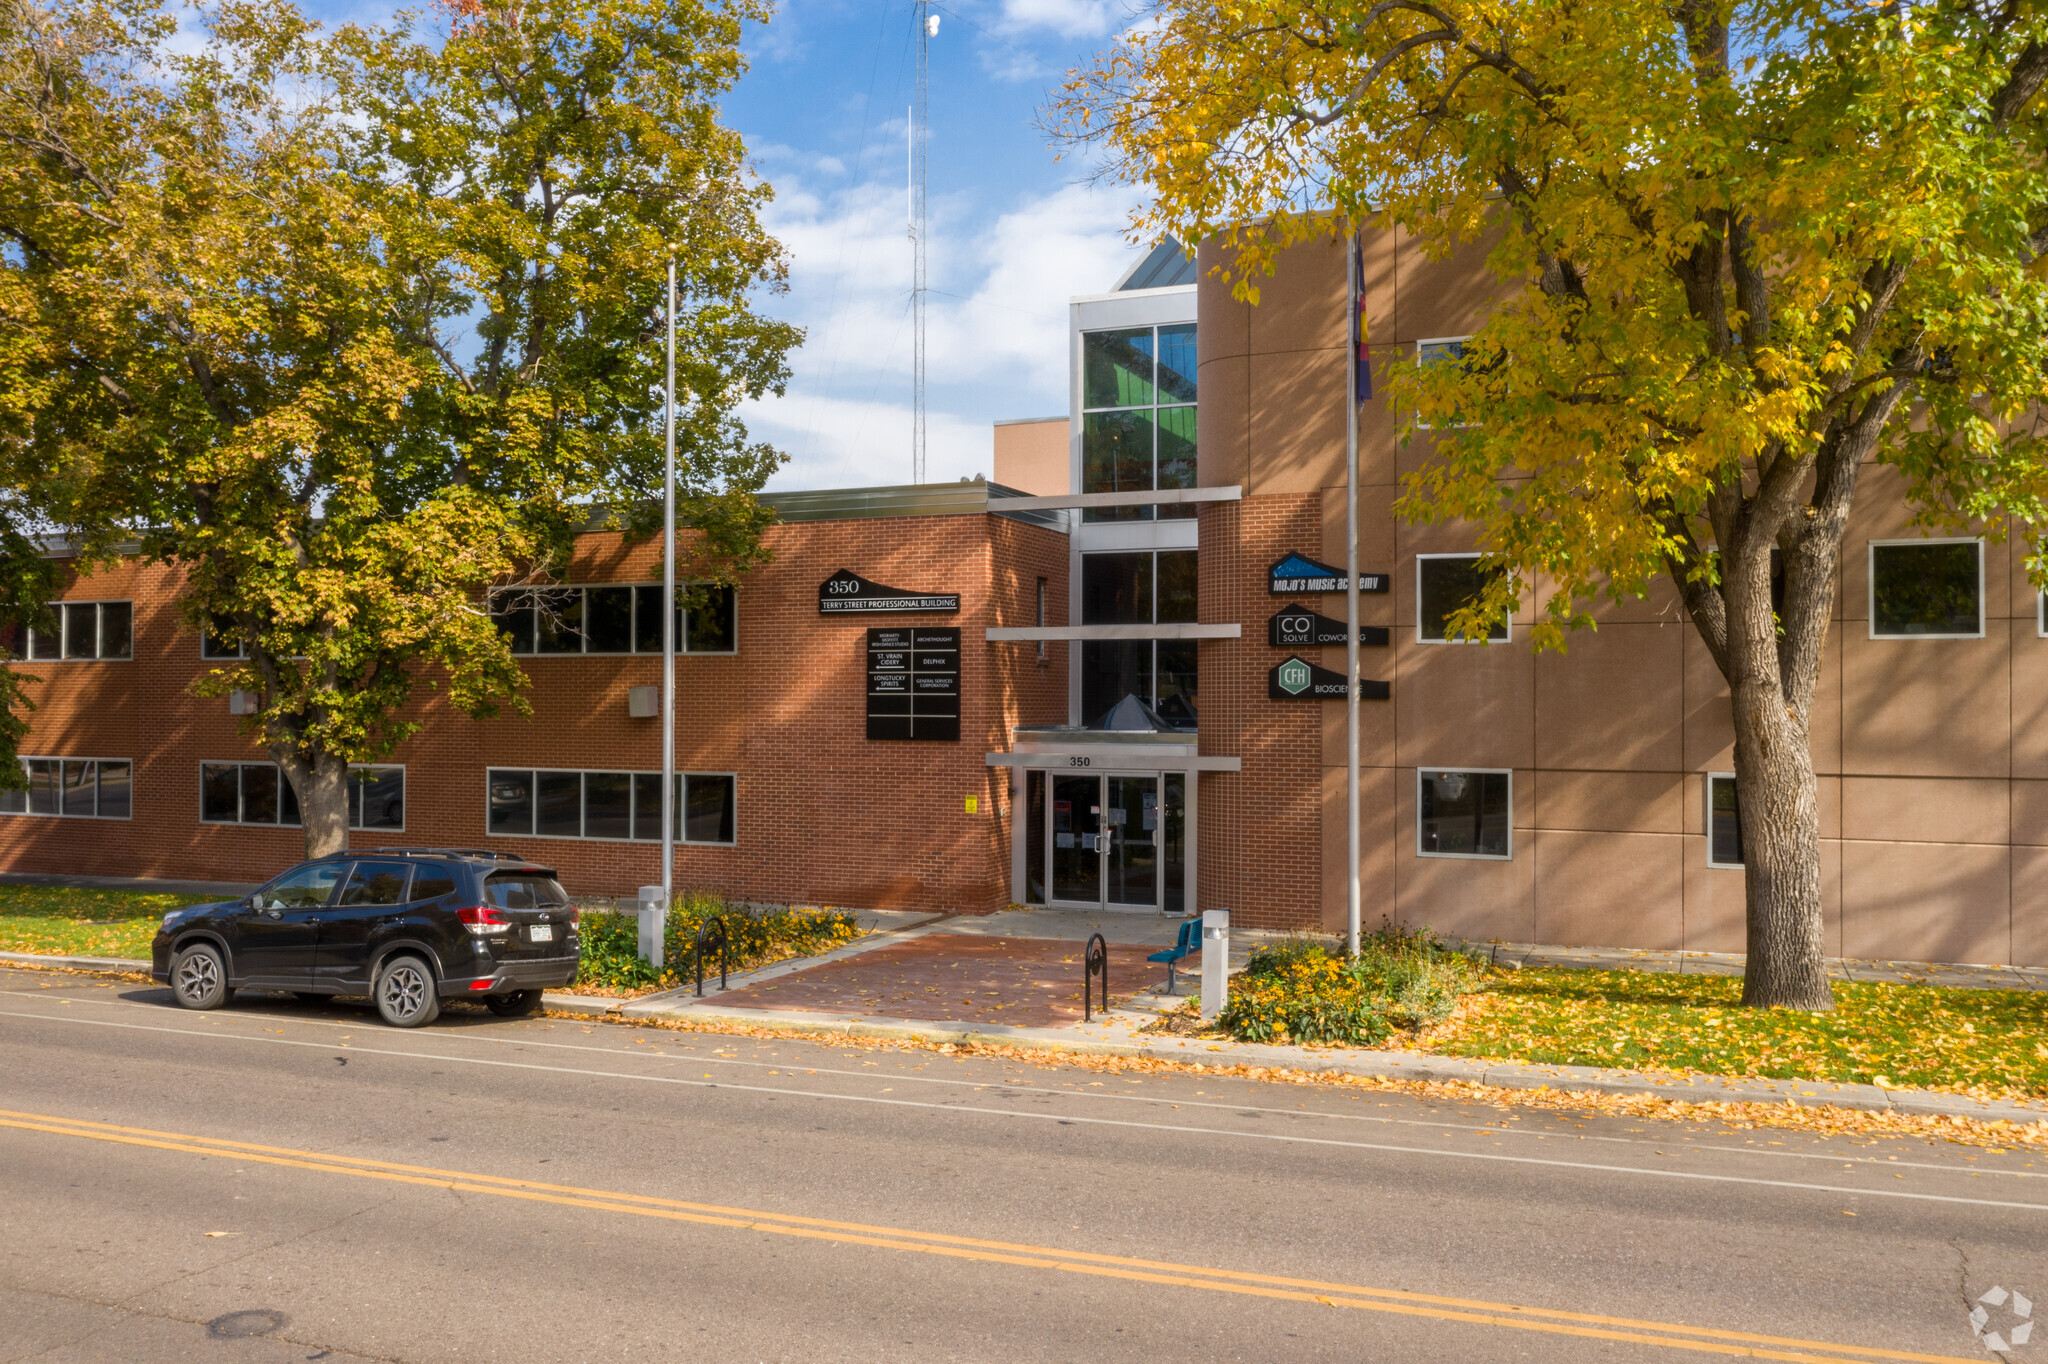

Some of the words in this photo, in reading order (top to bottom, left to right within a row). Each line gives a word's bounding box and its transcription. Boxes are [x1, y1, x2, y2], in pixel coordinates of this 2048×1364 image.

[829, 580, 859, 594] 350
[822, 601, 843, 609] TERRY
[844, 601, 867, 609] STREET
[868, 600, 920, 608] PROFESSIONAL
[920, 599, 956, 607] BUILDING
[1281, 617, 1310, 633] CO
[1283, 634, 1308, 642] SOLVE
[1318, 634, 1366, 642] COWORG
[1284, 668, 1306, 683] CFH
[1070, 757, 1091, 767] 350
